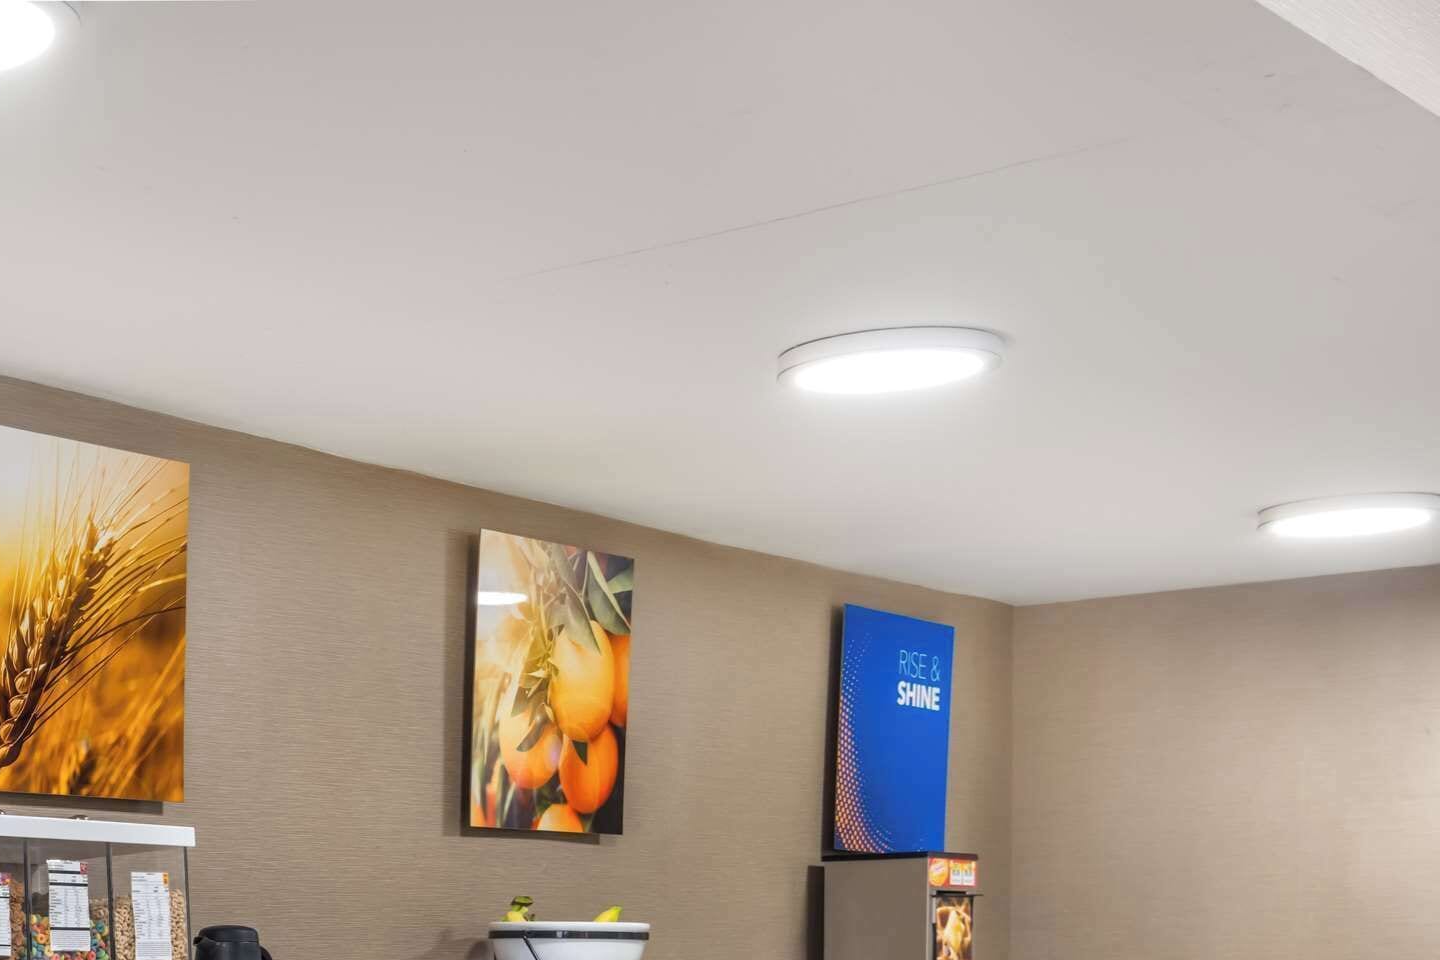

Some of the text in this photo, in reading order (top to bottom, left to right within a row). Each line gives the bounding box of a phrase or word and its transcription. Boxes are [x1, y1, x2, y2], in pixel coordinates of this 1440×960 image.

[898, 649, 941, 682] RISE &
[897, 680, 941, 711] SHINE
